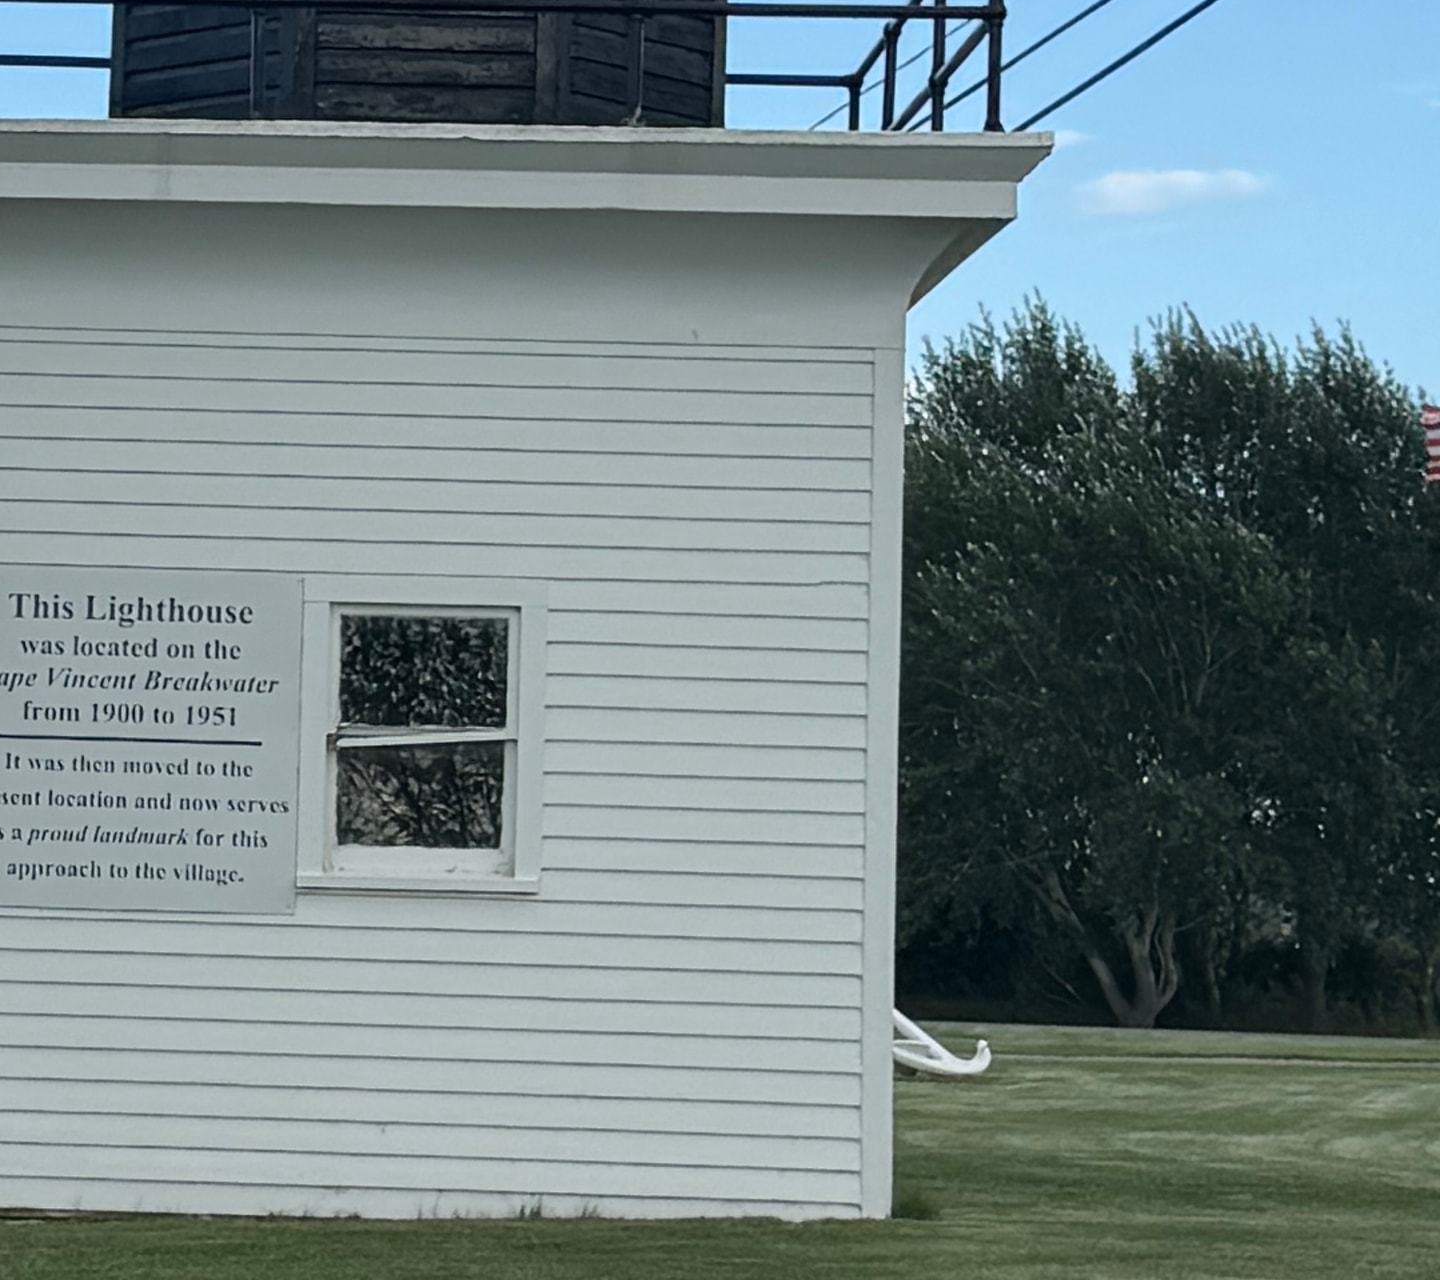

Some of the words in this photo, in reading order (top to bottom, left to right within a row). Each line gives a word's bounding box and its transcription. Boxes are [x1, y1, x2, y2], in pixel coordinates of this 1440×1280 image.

[8, 592, 74, 620] This
[85, 594, 254, 629] Lighthouse
[20, 639, 65, 656] was
[73, 634, 158, 659] located
[166, 643, 195, 660] on
[204, 638, 242, 661] the
[47, 666, 137, 691] Vincent
[143, 669, 280, 694] Breakwater
[23, 700, 80, 723] from
[91, 702, 145, 724] 1900
[153, 707, 175, 725] to
[186, 705, 236, 727] 1951
[5, 751, 21, 770] It
[27, 757, 65, 772] was
[71, 754, 115, 774] then
[122, 757, 189, 776] moved
[196, 760, 216, 776] to
[222, 759, 254, 778] the
[48, 788, 127, 809] location
[134, 791, 172, 811] and
[179, 797, 219, 812] now
[227, 799, 290, 814] serves
[11, 827, 23, 841] a
[26, 824, 89, 847] proud
[92, 824, 188, 846] landmark
[195, 827, 225, 847] for
[231, 829, 268, 849] this
[6, 859, 102, 881] approach
[109, 863, 129, 879] to
[135, 861, 167, 881] the
[172, 863, 245, 887] village.
